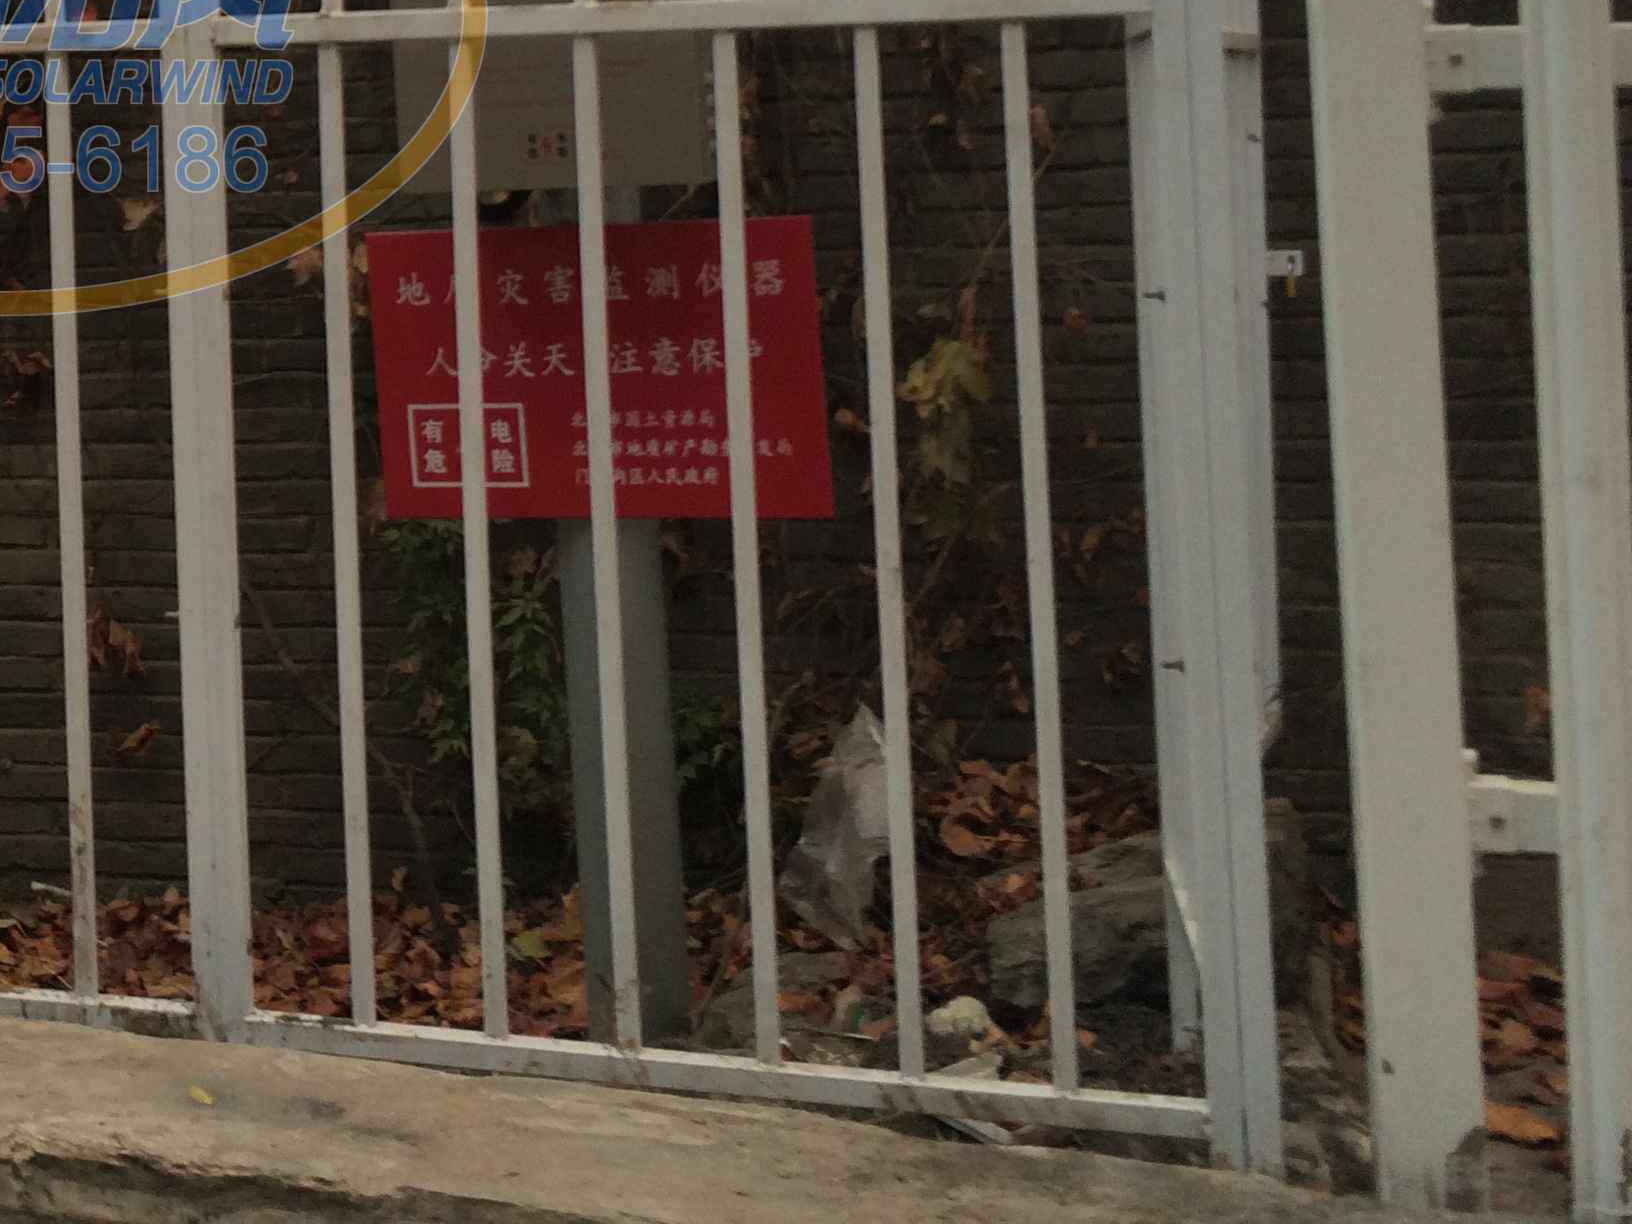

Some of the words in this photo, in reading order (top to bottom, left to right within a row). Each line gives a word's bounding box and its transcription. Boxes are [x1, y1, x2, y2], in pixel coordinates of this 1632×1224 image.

[395, 258, 786, 307] 地灾害监测仪器
